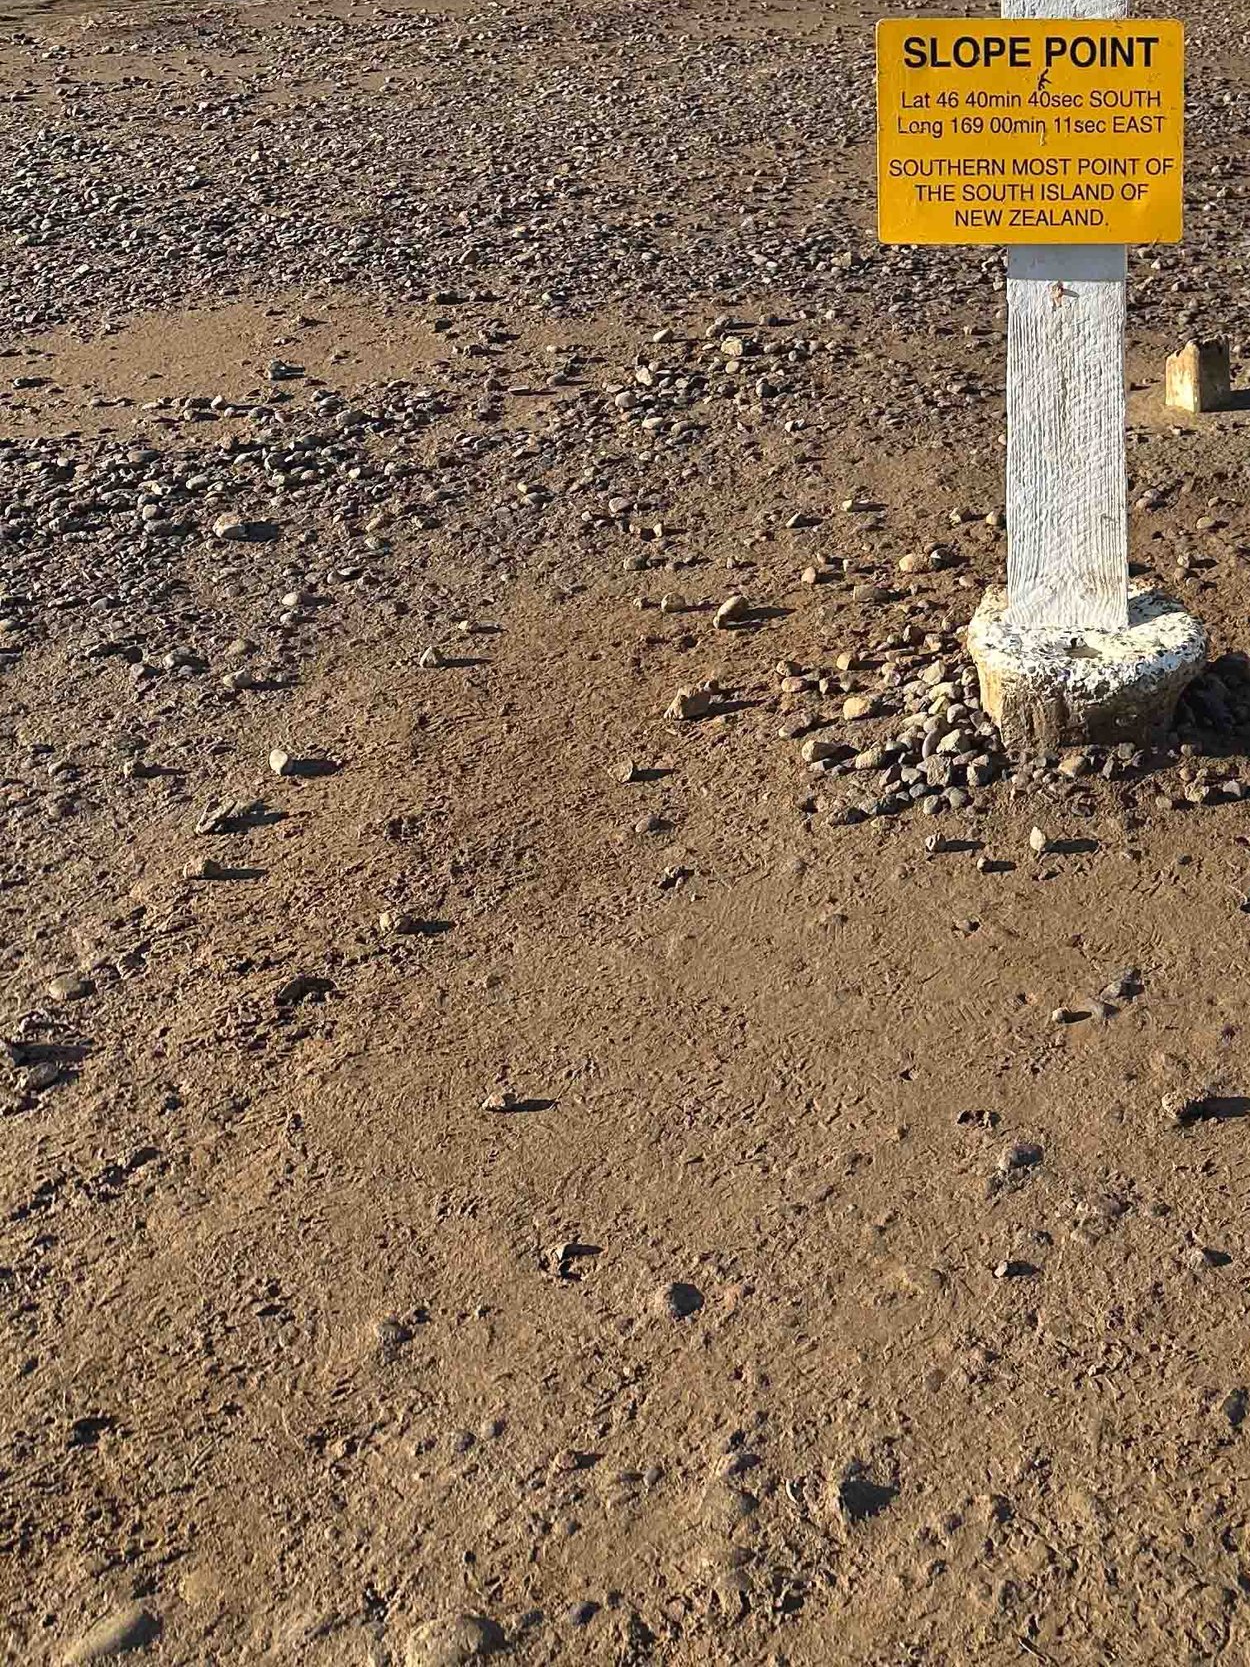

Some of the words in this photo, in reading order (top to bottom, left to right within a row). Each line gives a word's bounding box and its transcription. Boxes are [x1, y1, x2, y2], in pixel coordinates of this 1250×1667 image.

[903, 36, 1032, 68] SLOPE
[1045, 36, 1160, 68] POINT
[901, 91, 931, 109] Lat
[936, 91, 960, 108] 46
[965, 90, 1022, 108] 40min
[1028, 91, 1084, 108] 40sec
[1089, 90, 1161, 108] SOUTH
[897, 116, 944, 139] Long
[951, 116, 984, 134] 169
[990, 116, 1046, 134] 00min
[1054, 116, 1107, 134] 11sec
[1113, 115, 1166, 133] EAST
[889, 159, 1006, 177] SOUTHERN
[1012, 158, 1072, 176] MOST
[1078, 158, 1140, 176] POINT
[1145, 158, 1175, 175] OF
[914, 184, 956, 202] THE
[962, 184, 1034, 202] SOUTH
[1041, 183, 1115, 201] ISLAND
[1121, 183, 1150, 201] OF
[954, 209, 1003, 227] NEW
[1008, 209, 1109, 227] ZEALAND.
